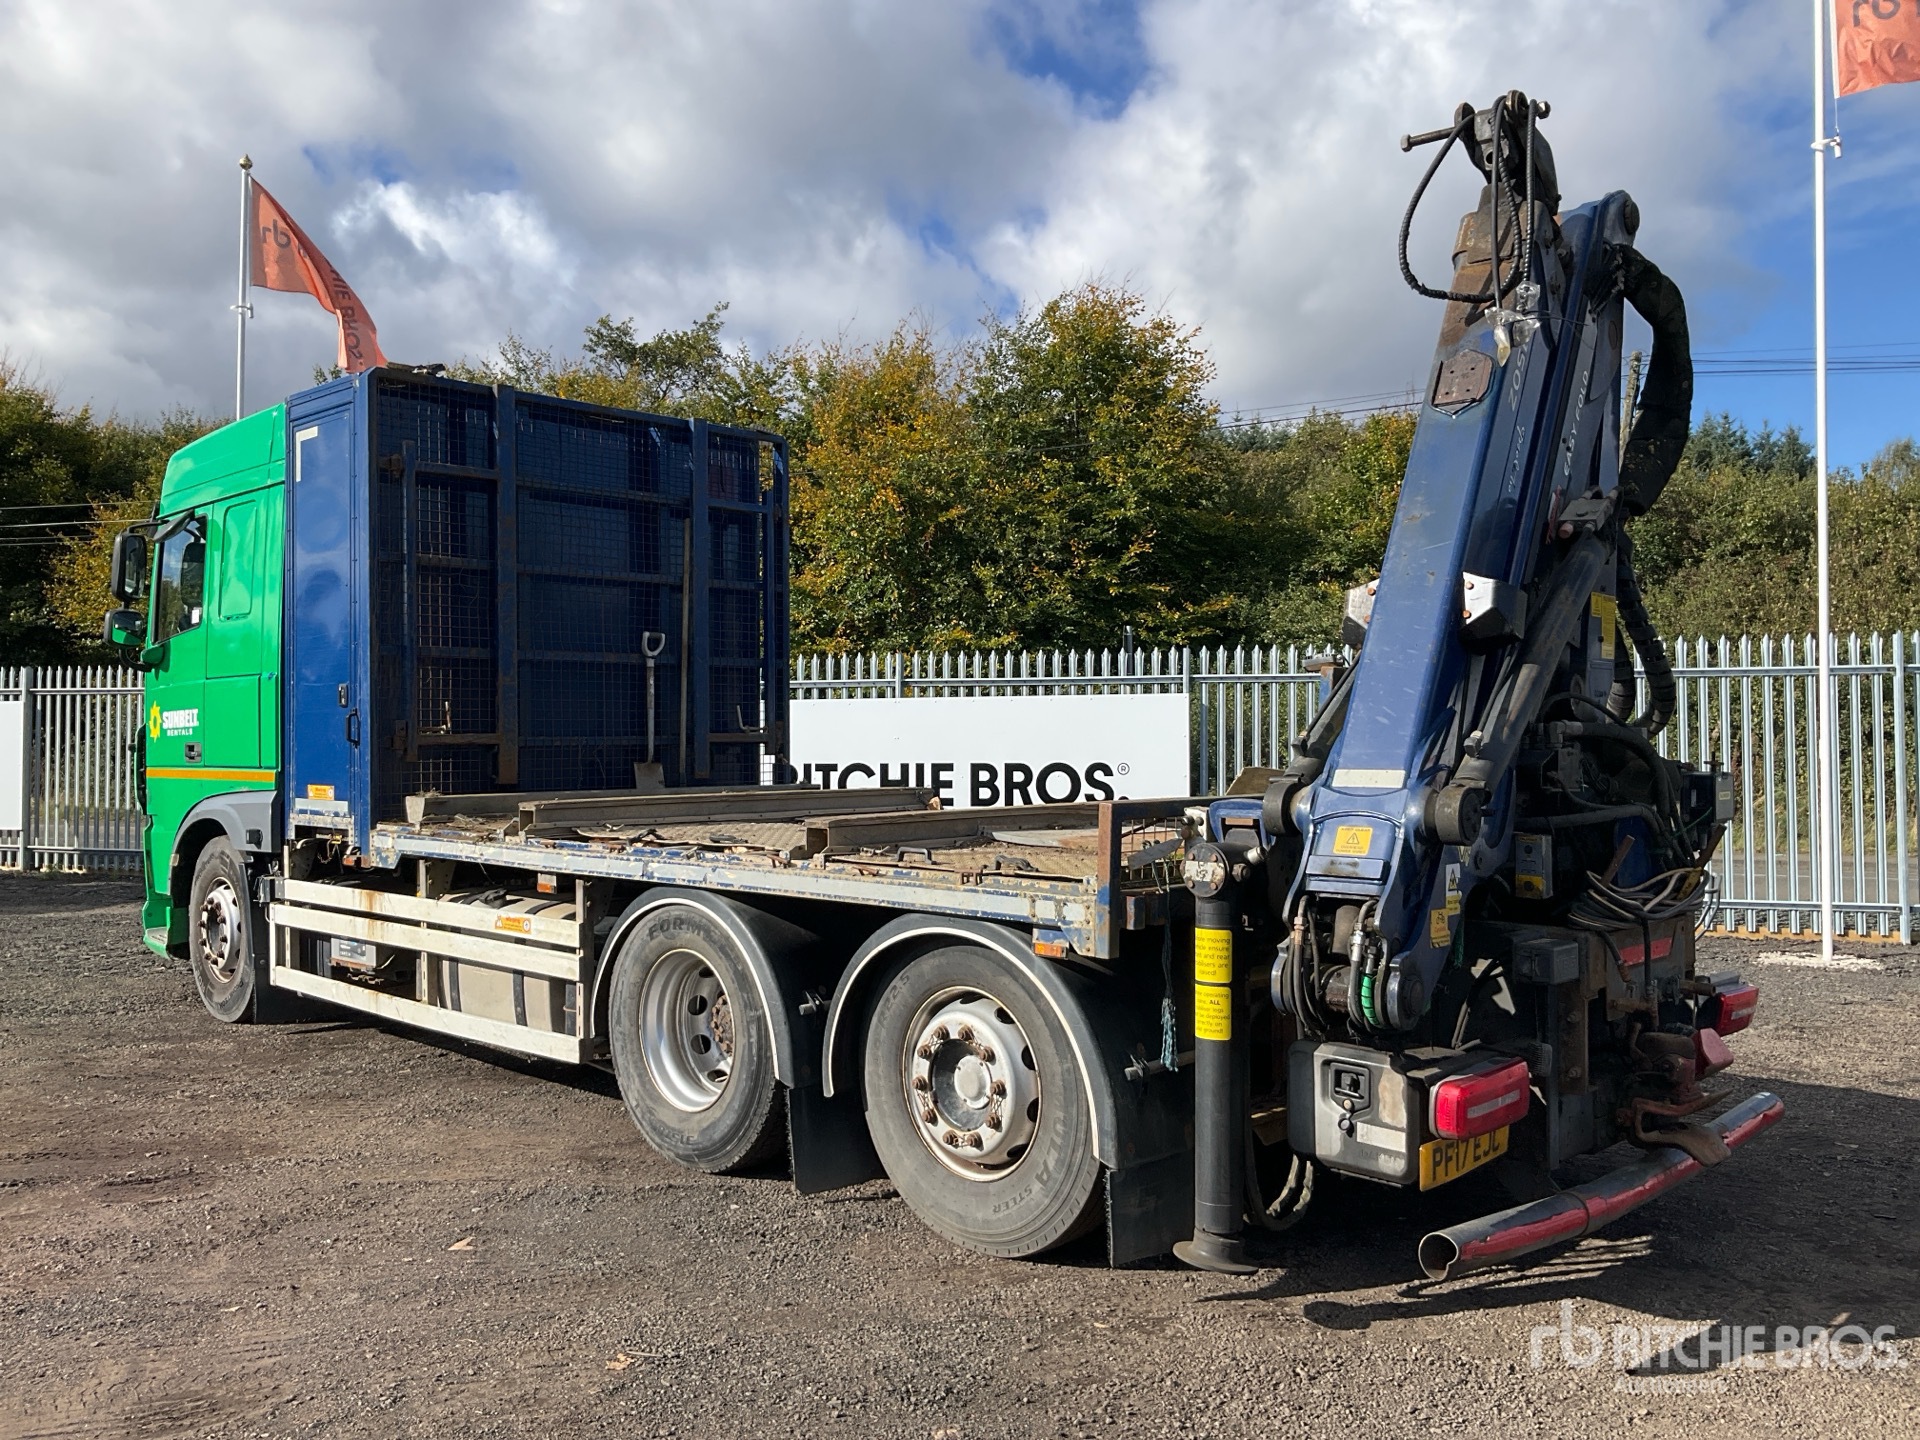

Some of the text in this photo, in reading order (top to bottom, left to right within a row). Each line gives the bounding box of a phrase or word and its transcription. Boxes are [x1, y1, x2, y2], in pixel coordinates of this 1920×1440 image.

[261, 219, 291, 248] rb
[1564, 370, 1589, 476] EASY FOLD
[167, 728, 193, 736] RENTALS
[1207, 937, 1230, 945] moving
[1431, 1139, 1470, 1183] PF17
[992, 1184, 1033, 1214] STEER
